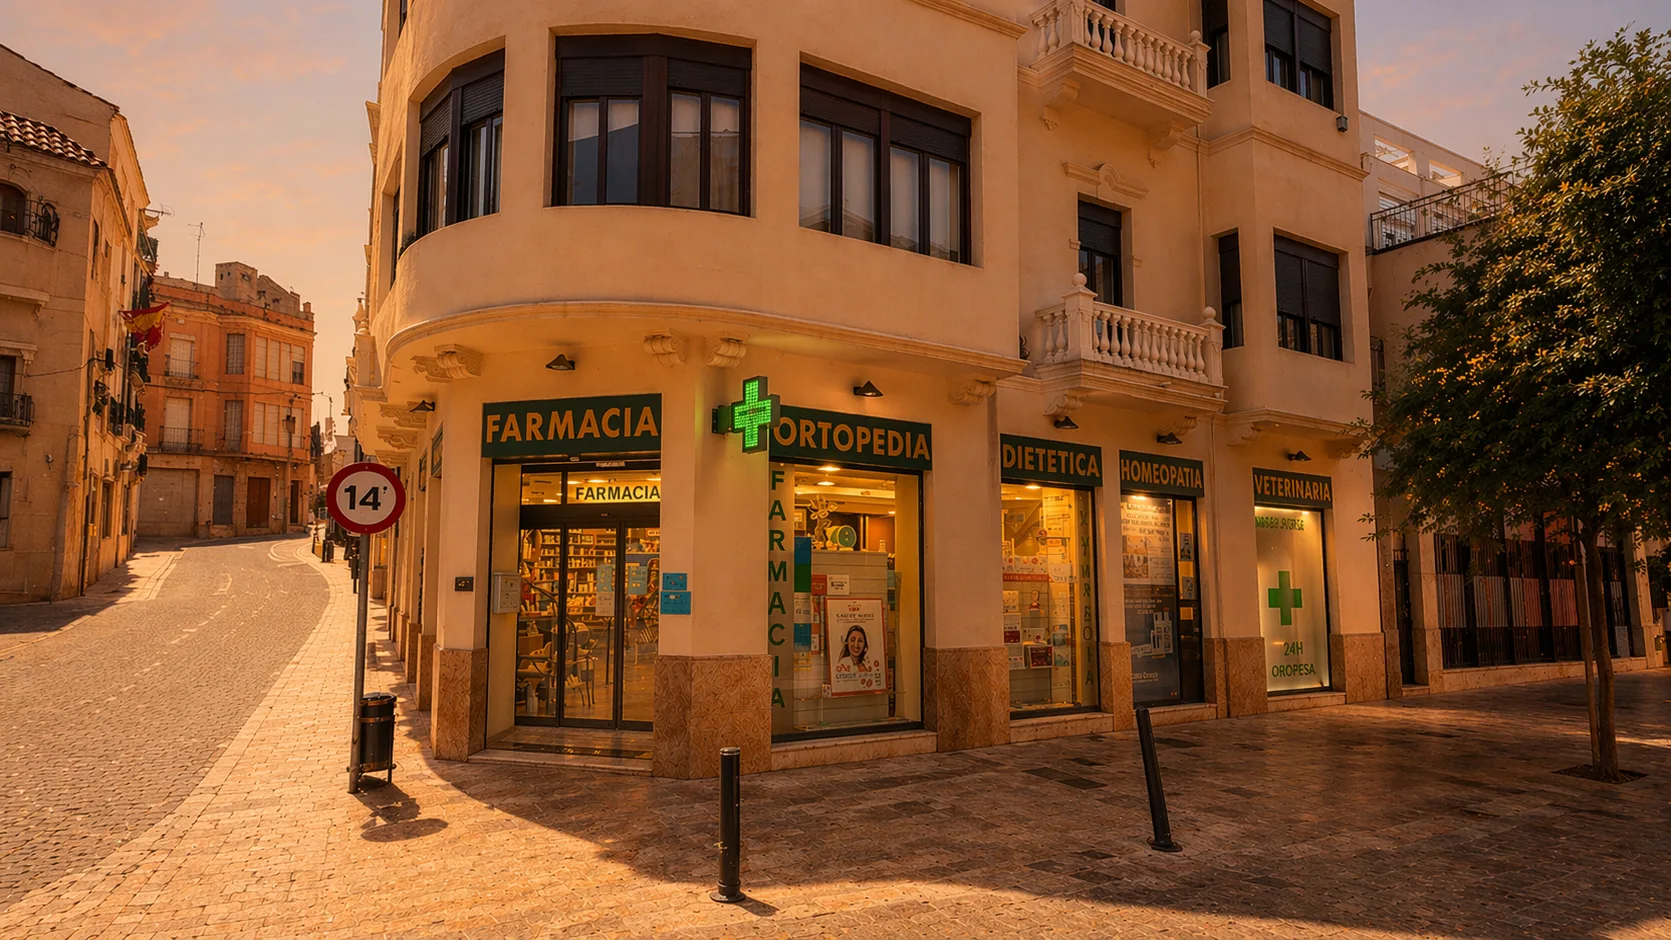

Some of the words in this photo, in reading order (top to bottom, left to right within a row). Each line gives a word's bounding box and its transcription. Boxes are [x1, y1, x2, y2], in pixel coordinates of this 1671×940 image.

[486, 406, 659, 443] FARMACIA
[773, 416, 930, 460] ORTOPEDIA
[1002, 444, 1100, 477] DIETETICA
[1121, 458, 1202, 489] HOMEOPATIA
[575, 485, 660, 500] FARMACIA
[1254, 474, 1331, 502] VETERINARIA
[768, 471, 787, 708] FARMACIA
[1283, 641, 1304, 656] 24H
[1271, 663, 1316, 678] OROPESA
